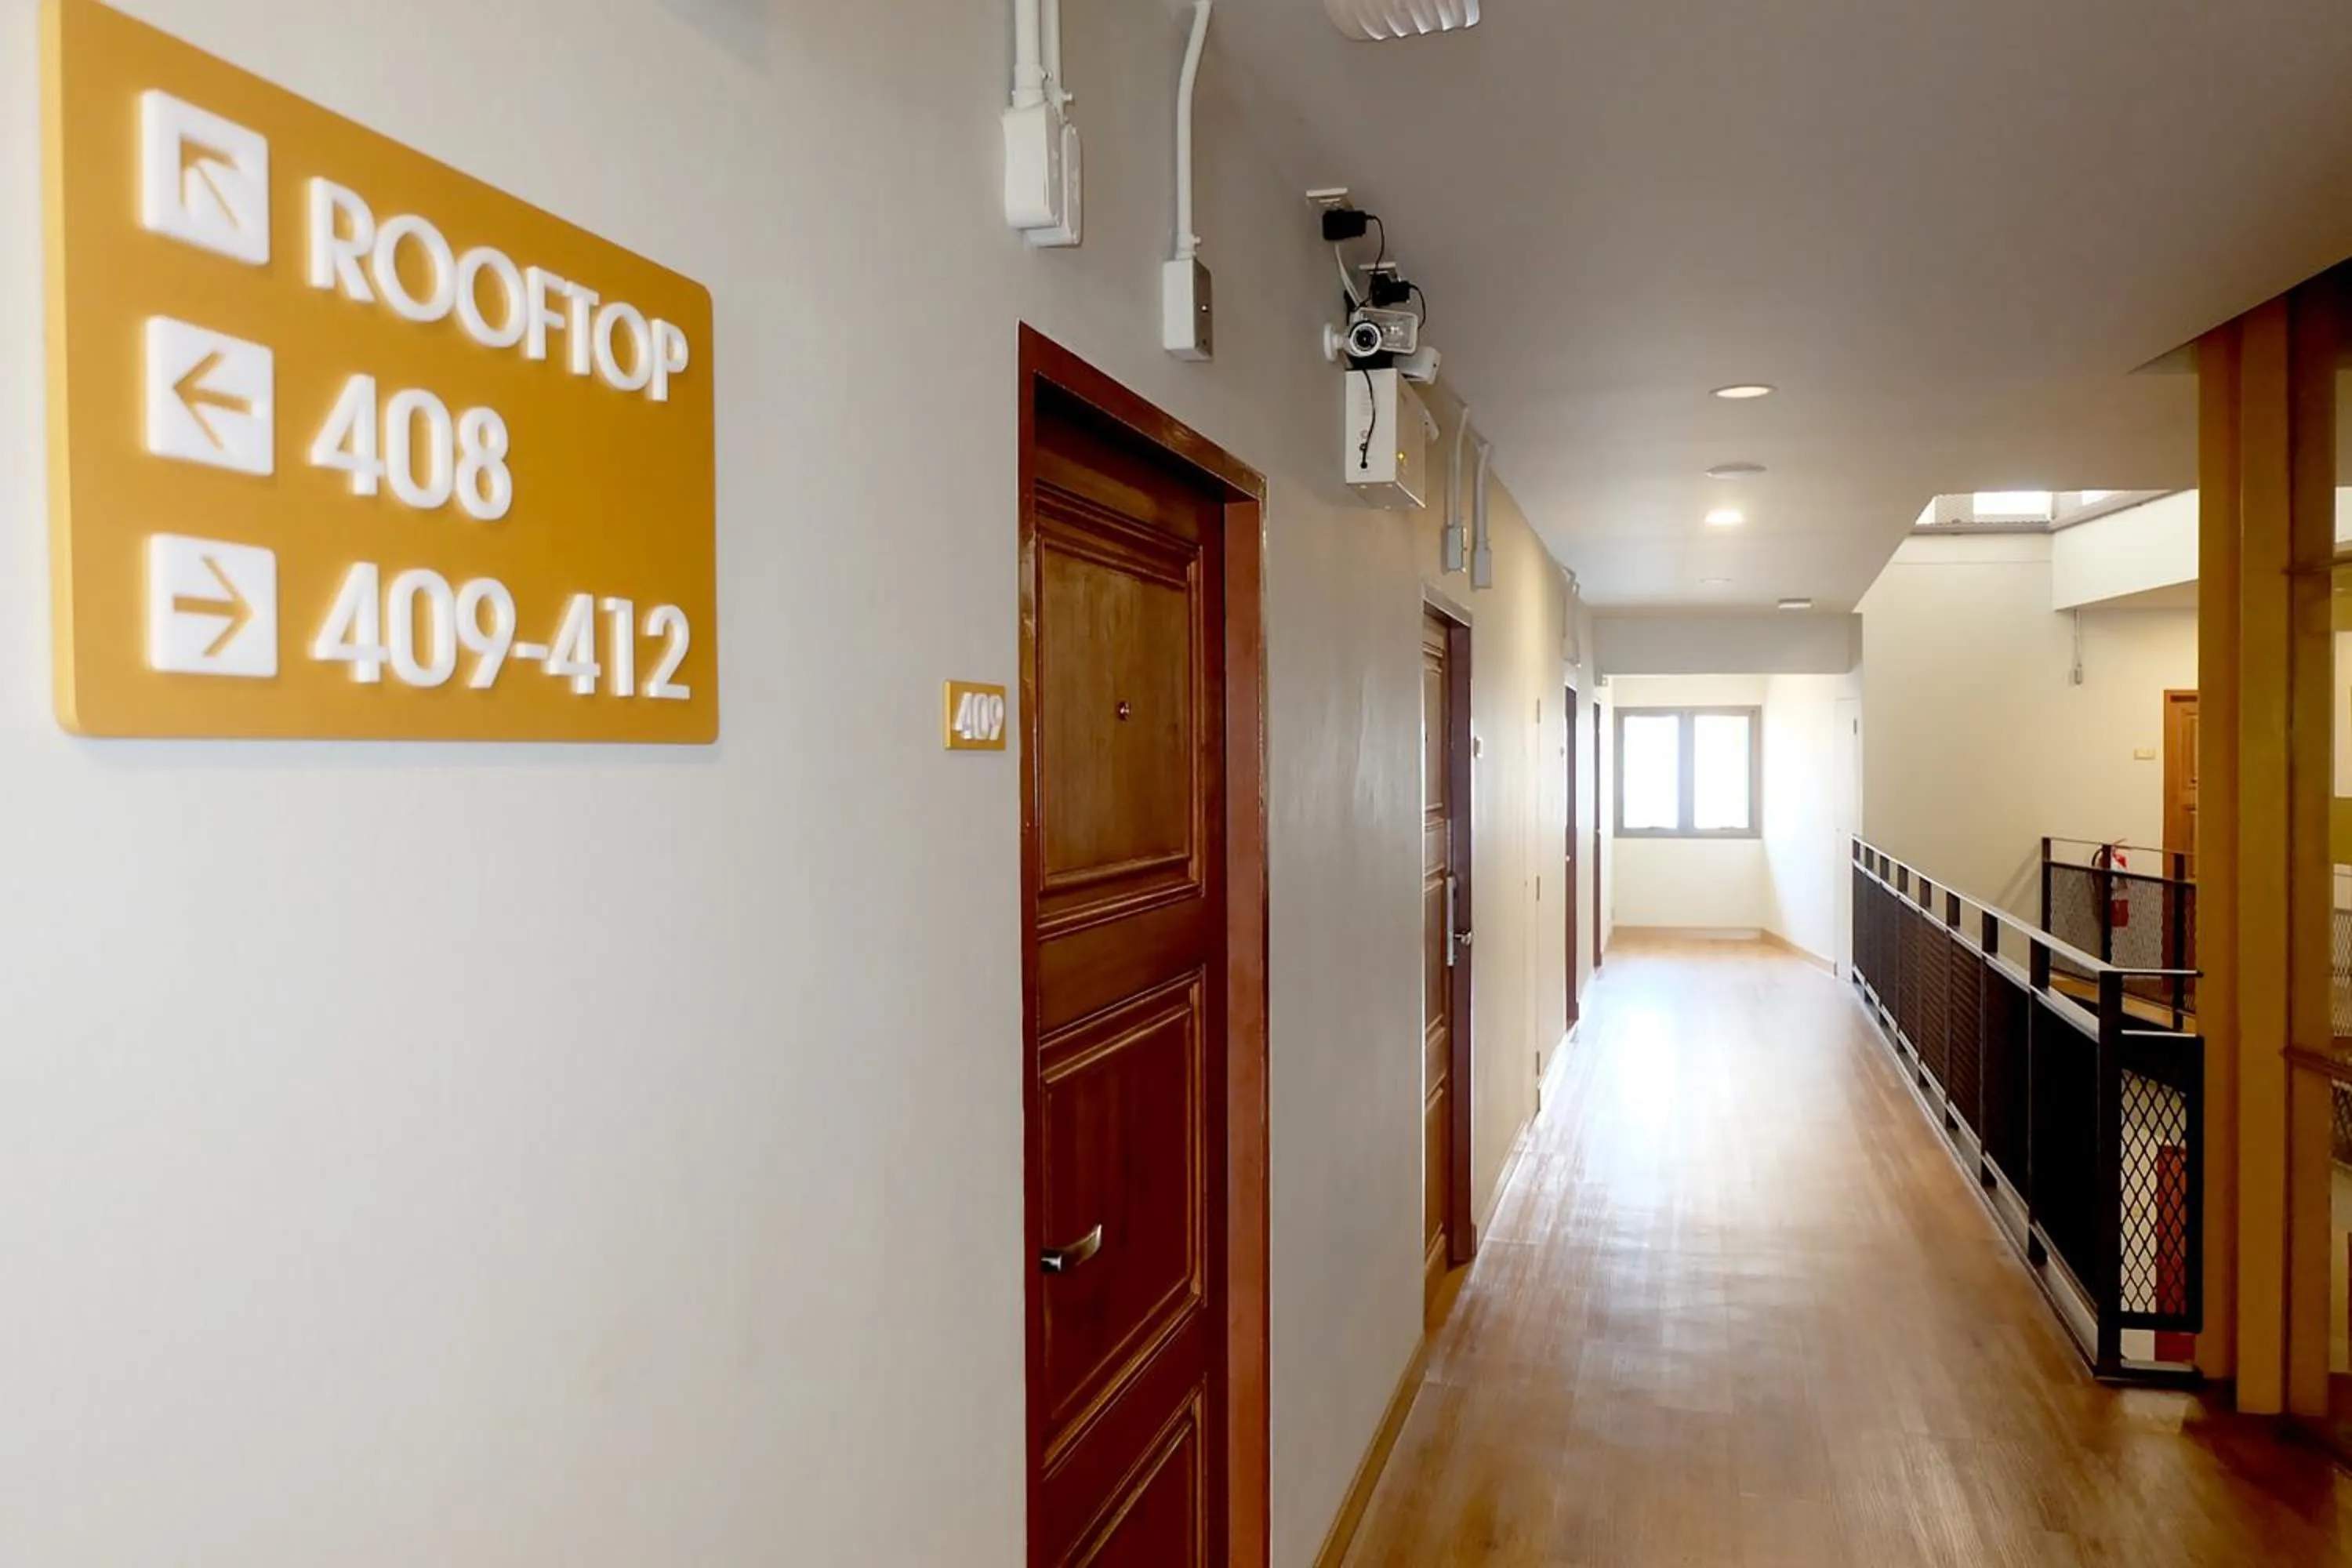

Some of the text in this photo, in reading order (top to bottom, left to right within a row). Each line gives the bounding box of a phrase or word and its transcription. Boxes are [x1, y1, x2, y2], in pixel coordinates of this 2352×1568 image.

[307, 176, 689, 401] ROOFTOP
[307, 374, 513, 519] 408
[310, 562, 691, 699] 409-412
[953, 691, 1004, 740] 409
